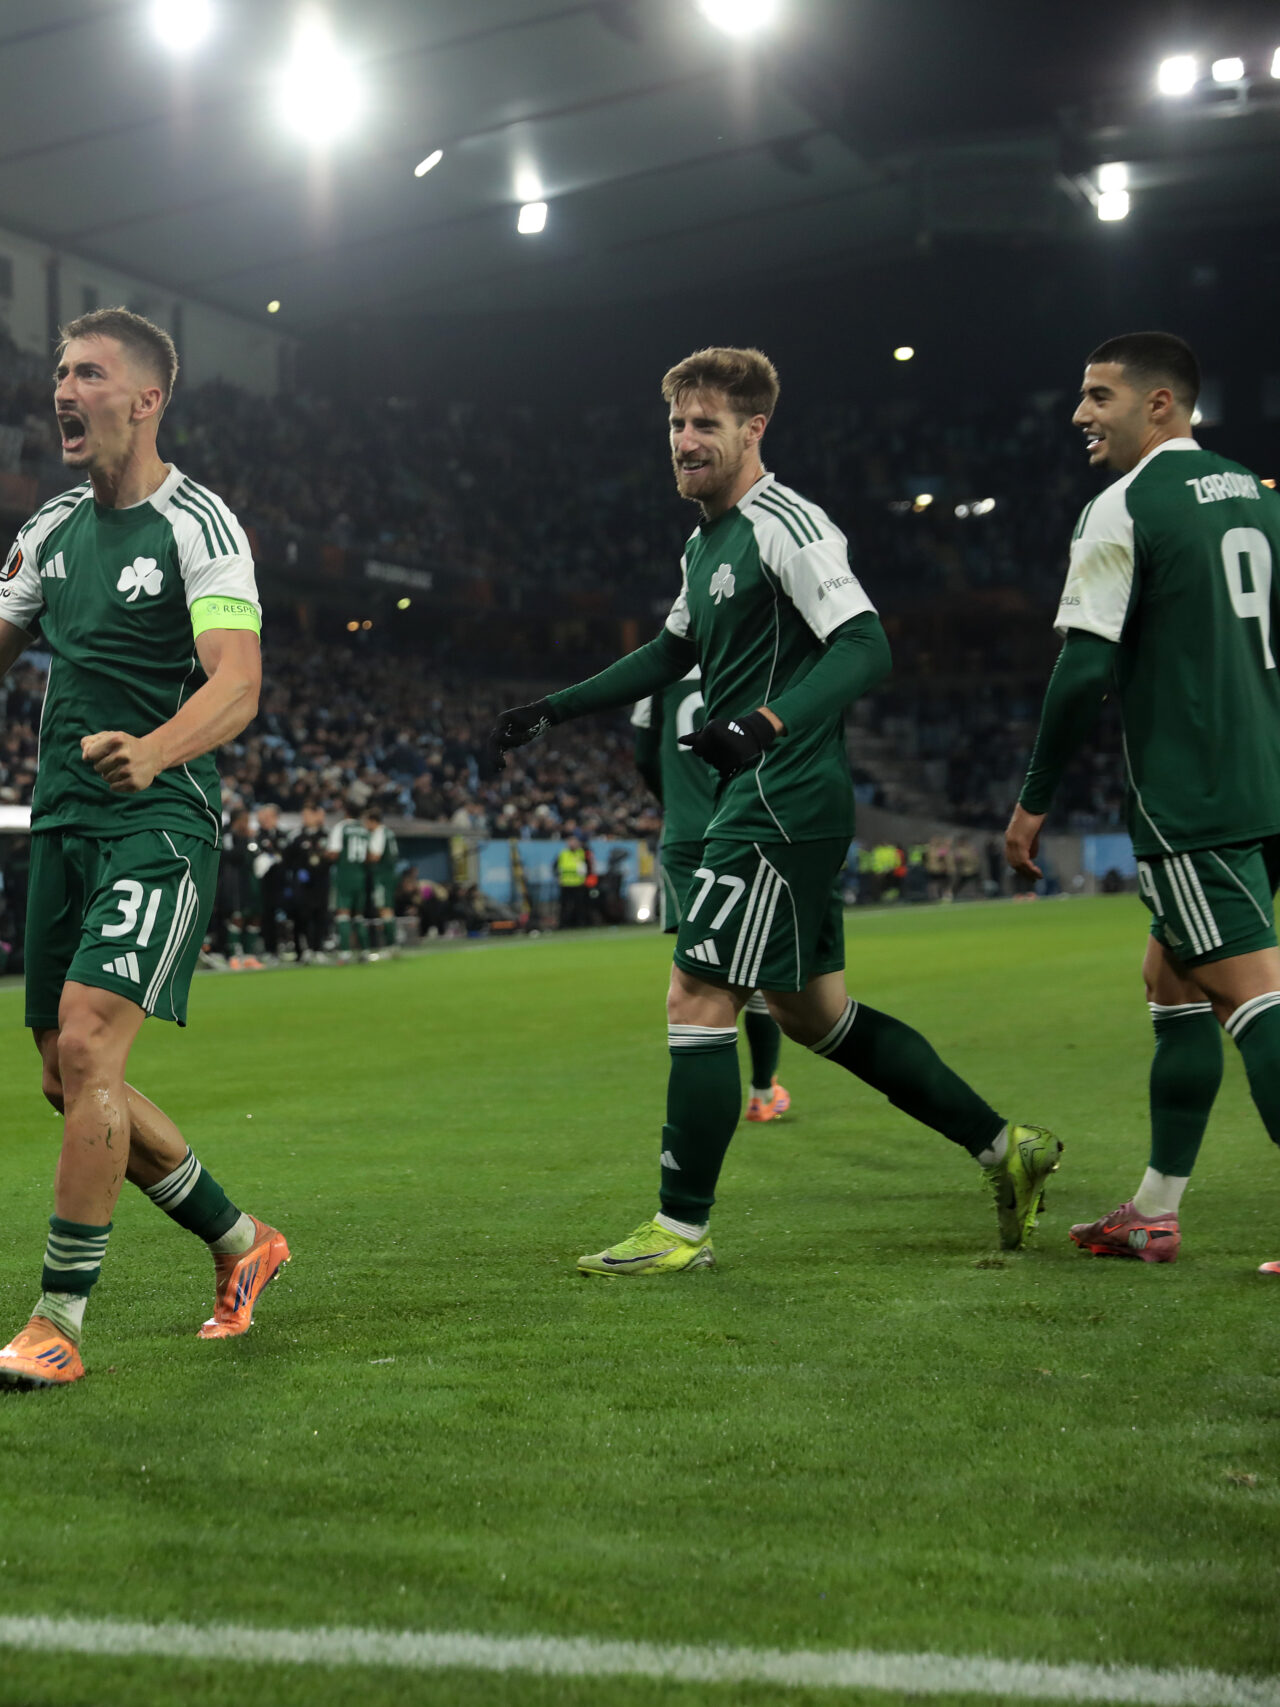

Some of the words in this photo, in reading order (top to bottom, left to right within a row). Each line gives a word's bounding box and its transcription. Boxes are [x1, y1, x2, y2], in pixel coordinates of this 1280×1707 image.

[1221, 526, 1277, 670] 9
[101, 879, 163, 947] 31
[686, 867, 746, 931] 77
[1137, 861, 1165, 917] 9
